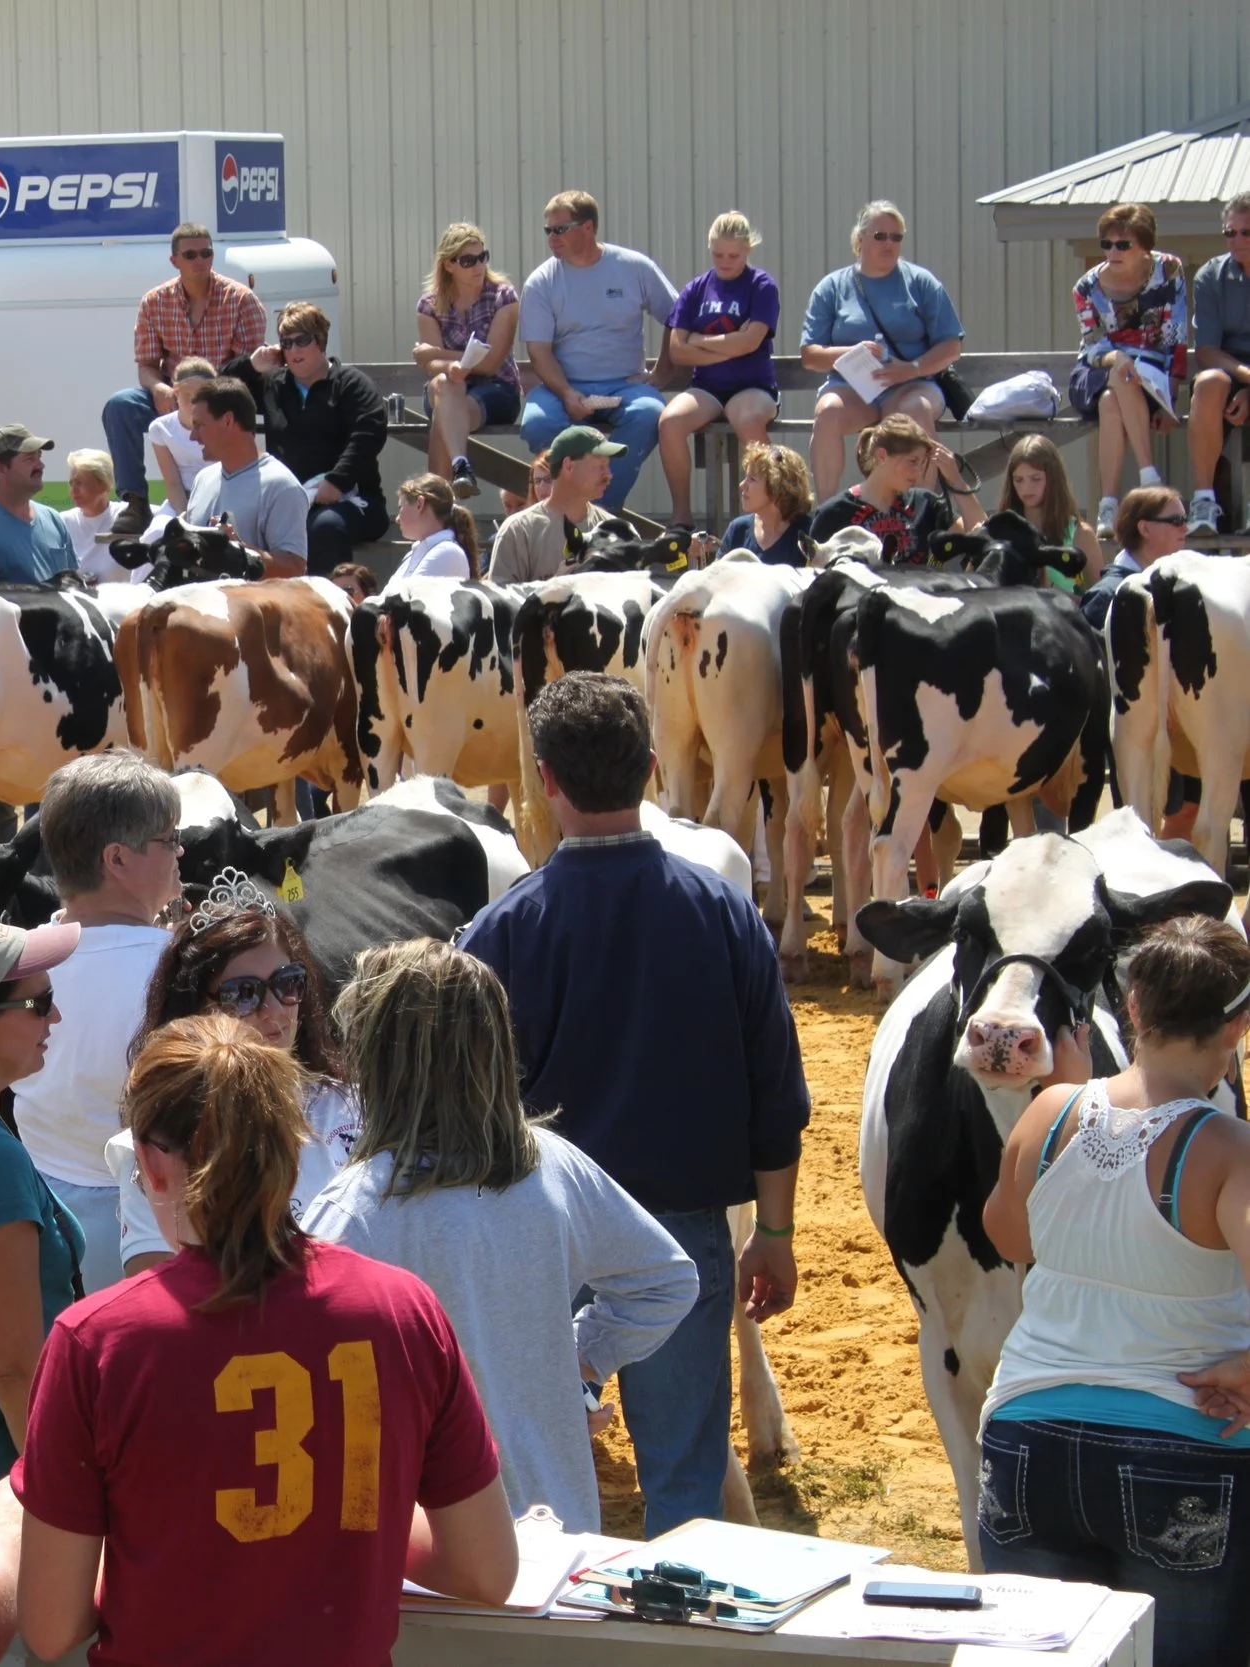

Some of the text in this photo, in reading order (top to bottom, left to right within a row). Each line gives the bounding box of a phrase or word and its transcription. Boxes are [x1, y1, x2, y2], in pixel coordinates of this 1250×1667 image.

[14, 172, 159, 212] PEPSI
[240, 166, 279, 202] PEPSI
[699, 300, 741, 318] I'M A
[325, 1123, 355, 1147] GOODHUE
[214, 1340, 381, 1543] 31
